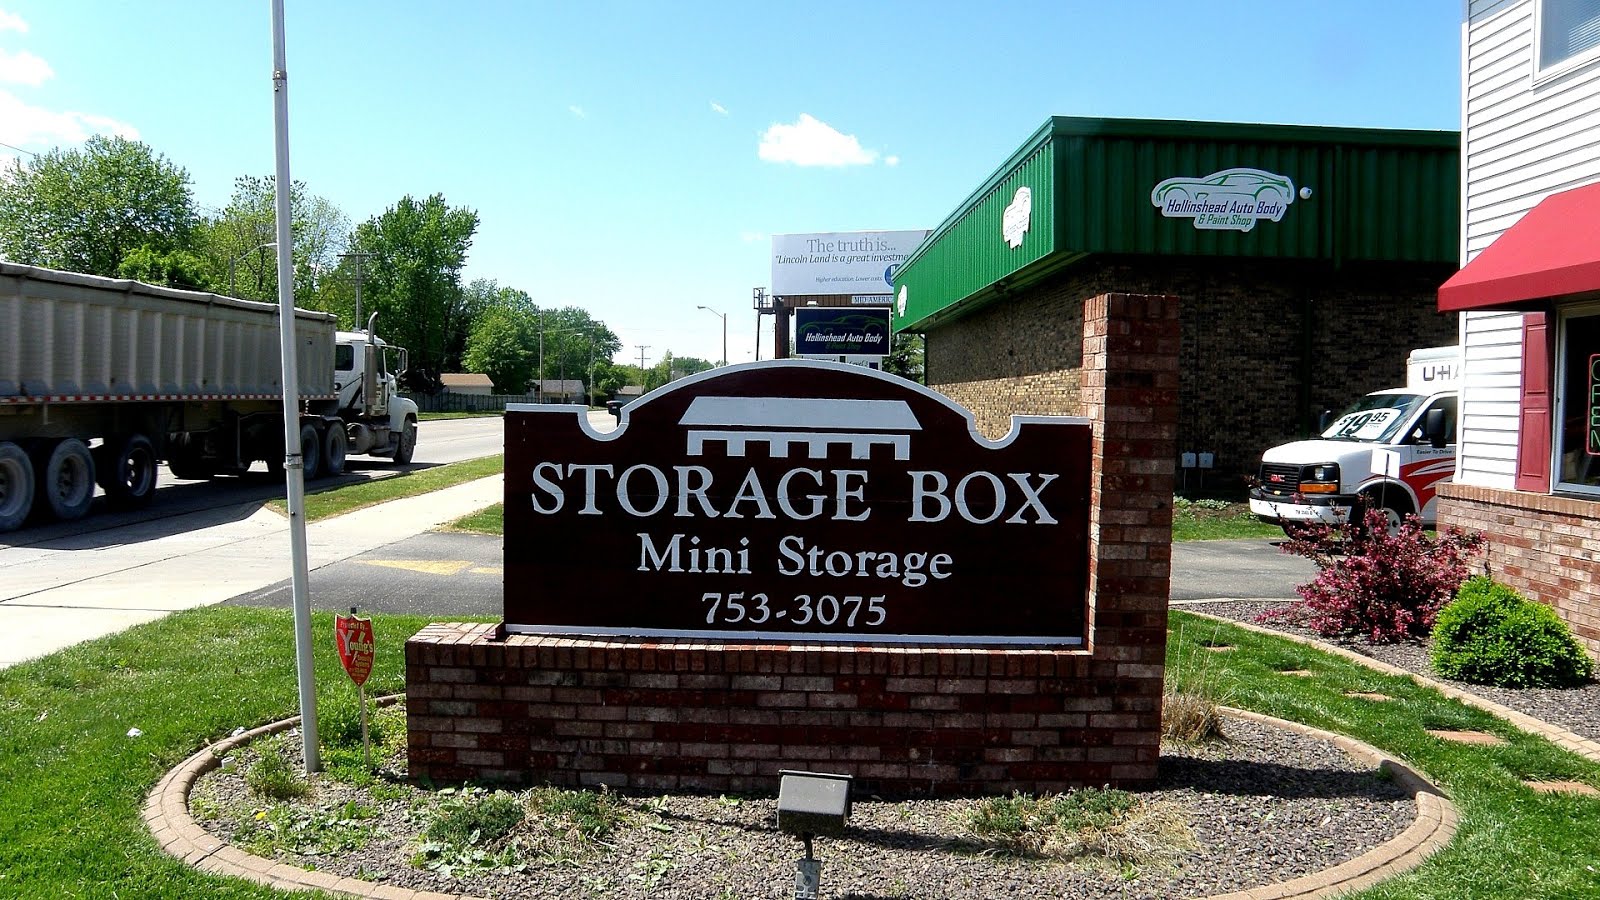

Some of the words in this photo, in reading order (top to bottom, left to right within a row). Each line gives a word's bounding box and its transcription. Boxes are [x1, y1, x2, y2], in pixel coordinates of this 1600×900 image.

[1166, 199, 1228, 213] Hollinshead
[1229, 200, 1254, 214] Auto
[1256, 201, 1282, 217] Body
[1198, 214, 1205, 224] &
[1206, 214, 1228, 225] Paint
[1230, 214, 1251, 227] Shop
[807, 238, 834, 253] The
[838, 237, 874, 252] truth
[876, 238, 896, 251] is...
[809, 253, 832, 263] Land
[832, 253, 838, 262] is
[845, 254, 870, 264] great
[871, 253, 909, 262] investme
[805, 332, 846, 342] Hollinshead
[846, 333, 864, 343] Auto
[864, 333, 883, 344] Body
[531, 461, 871, 521] STORAGE
[907, 470, 1060, 525] BOX
[636, 532, 752, 575] Mini
[778, 535, 953, 588] Storage
[701, 592, 887, 627] 753-3075
[337, 628, 373, 656] Young's
